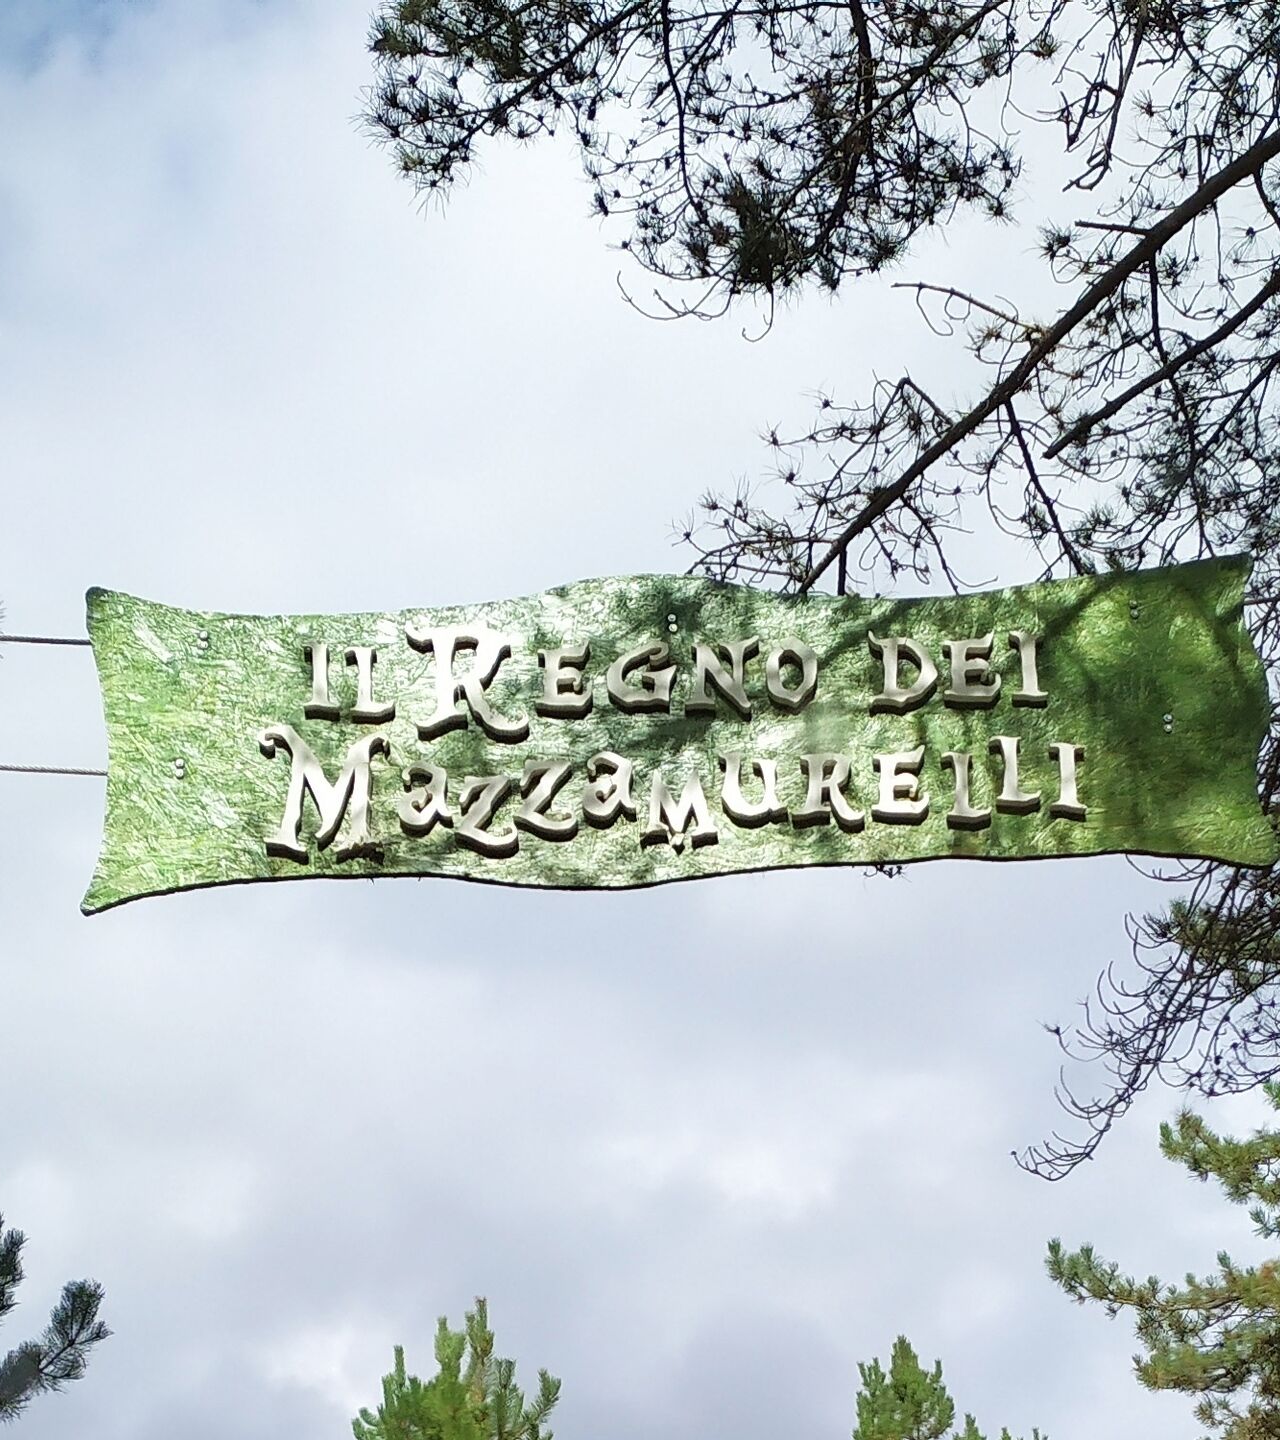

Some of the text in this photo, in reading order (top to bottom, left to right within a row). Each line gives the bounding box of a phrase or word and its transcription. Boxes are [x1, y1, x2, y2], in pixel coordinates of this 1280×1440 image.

[304, 621, 1050, 745] IL REGNO DEI
